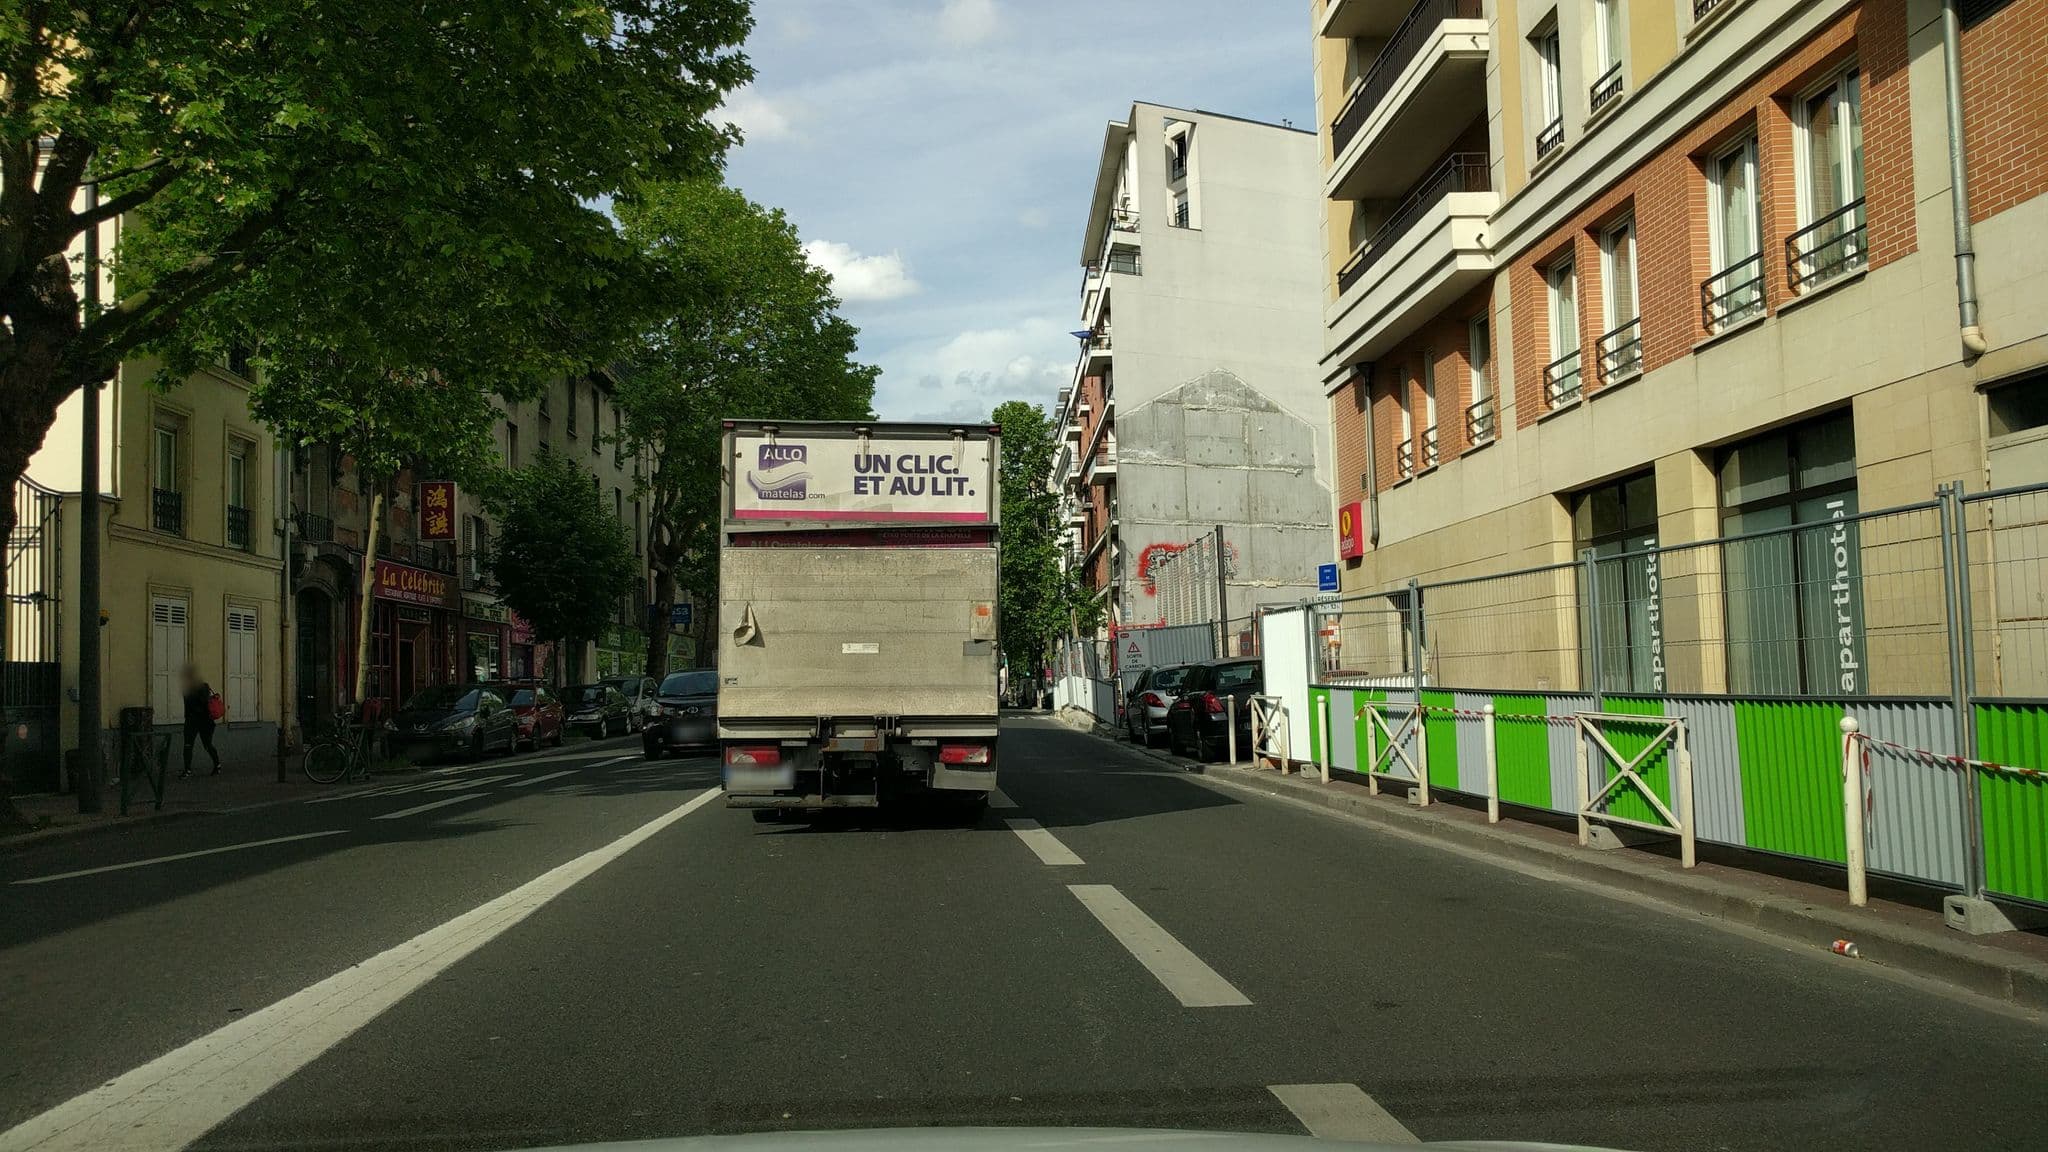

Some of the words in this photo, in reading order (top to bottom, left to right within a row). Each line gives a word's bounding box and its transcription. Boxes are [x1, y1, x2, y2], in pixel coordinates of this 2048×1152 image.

[763, 447, 802, 461] ALLO
[854, 454, 892, 474] UN
[896, 454, 960, 475] CLIC.
[761, 489, 805, 499] matelas
[853, 476, 886, 496] ET
[889, 476, 926, 496] AU
[931, 476, 976, 497] LIT.
[382, 566, 397, 586] La
[1826, 500, 1859, 692] aparthotel
[1643, 538, 1665, 692] aparthotel
